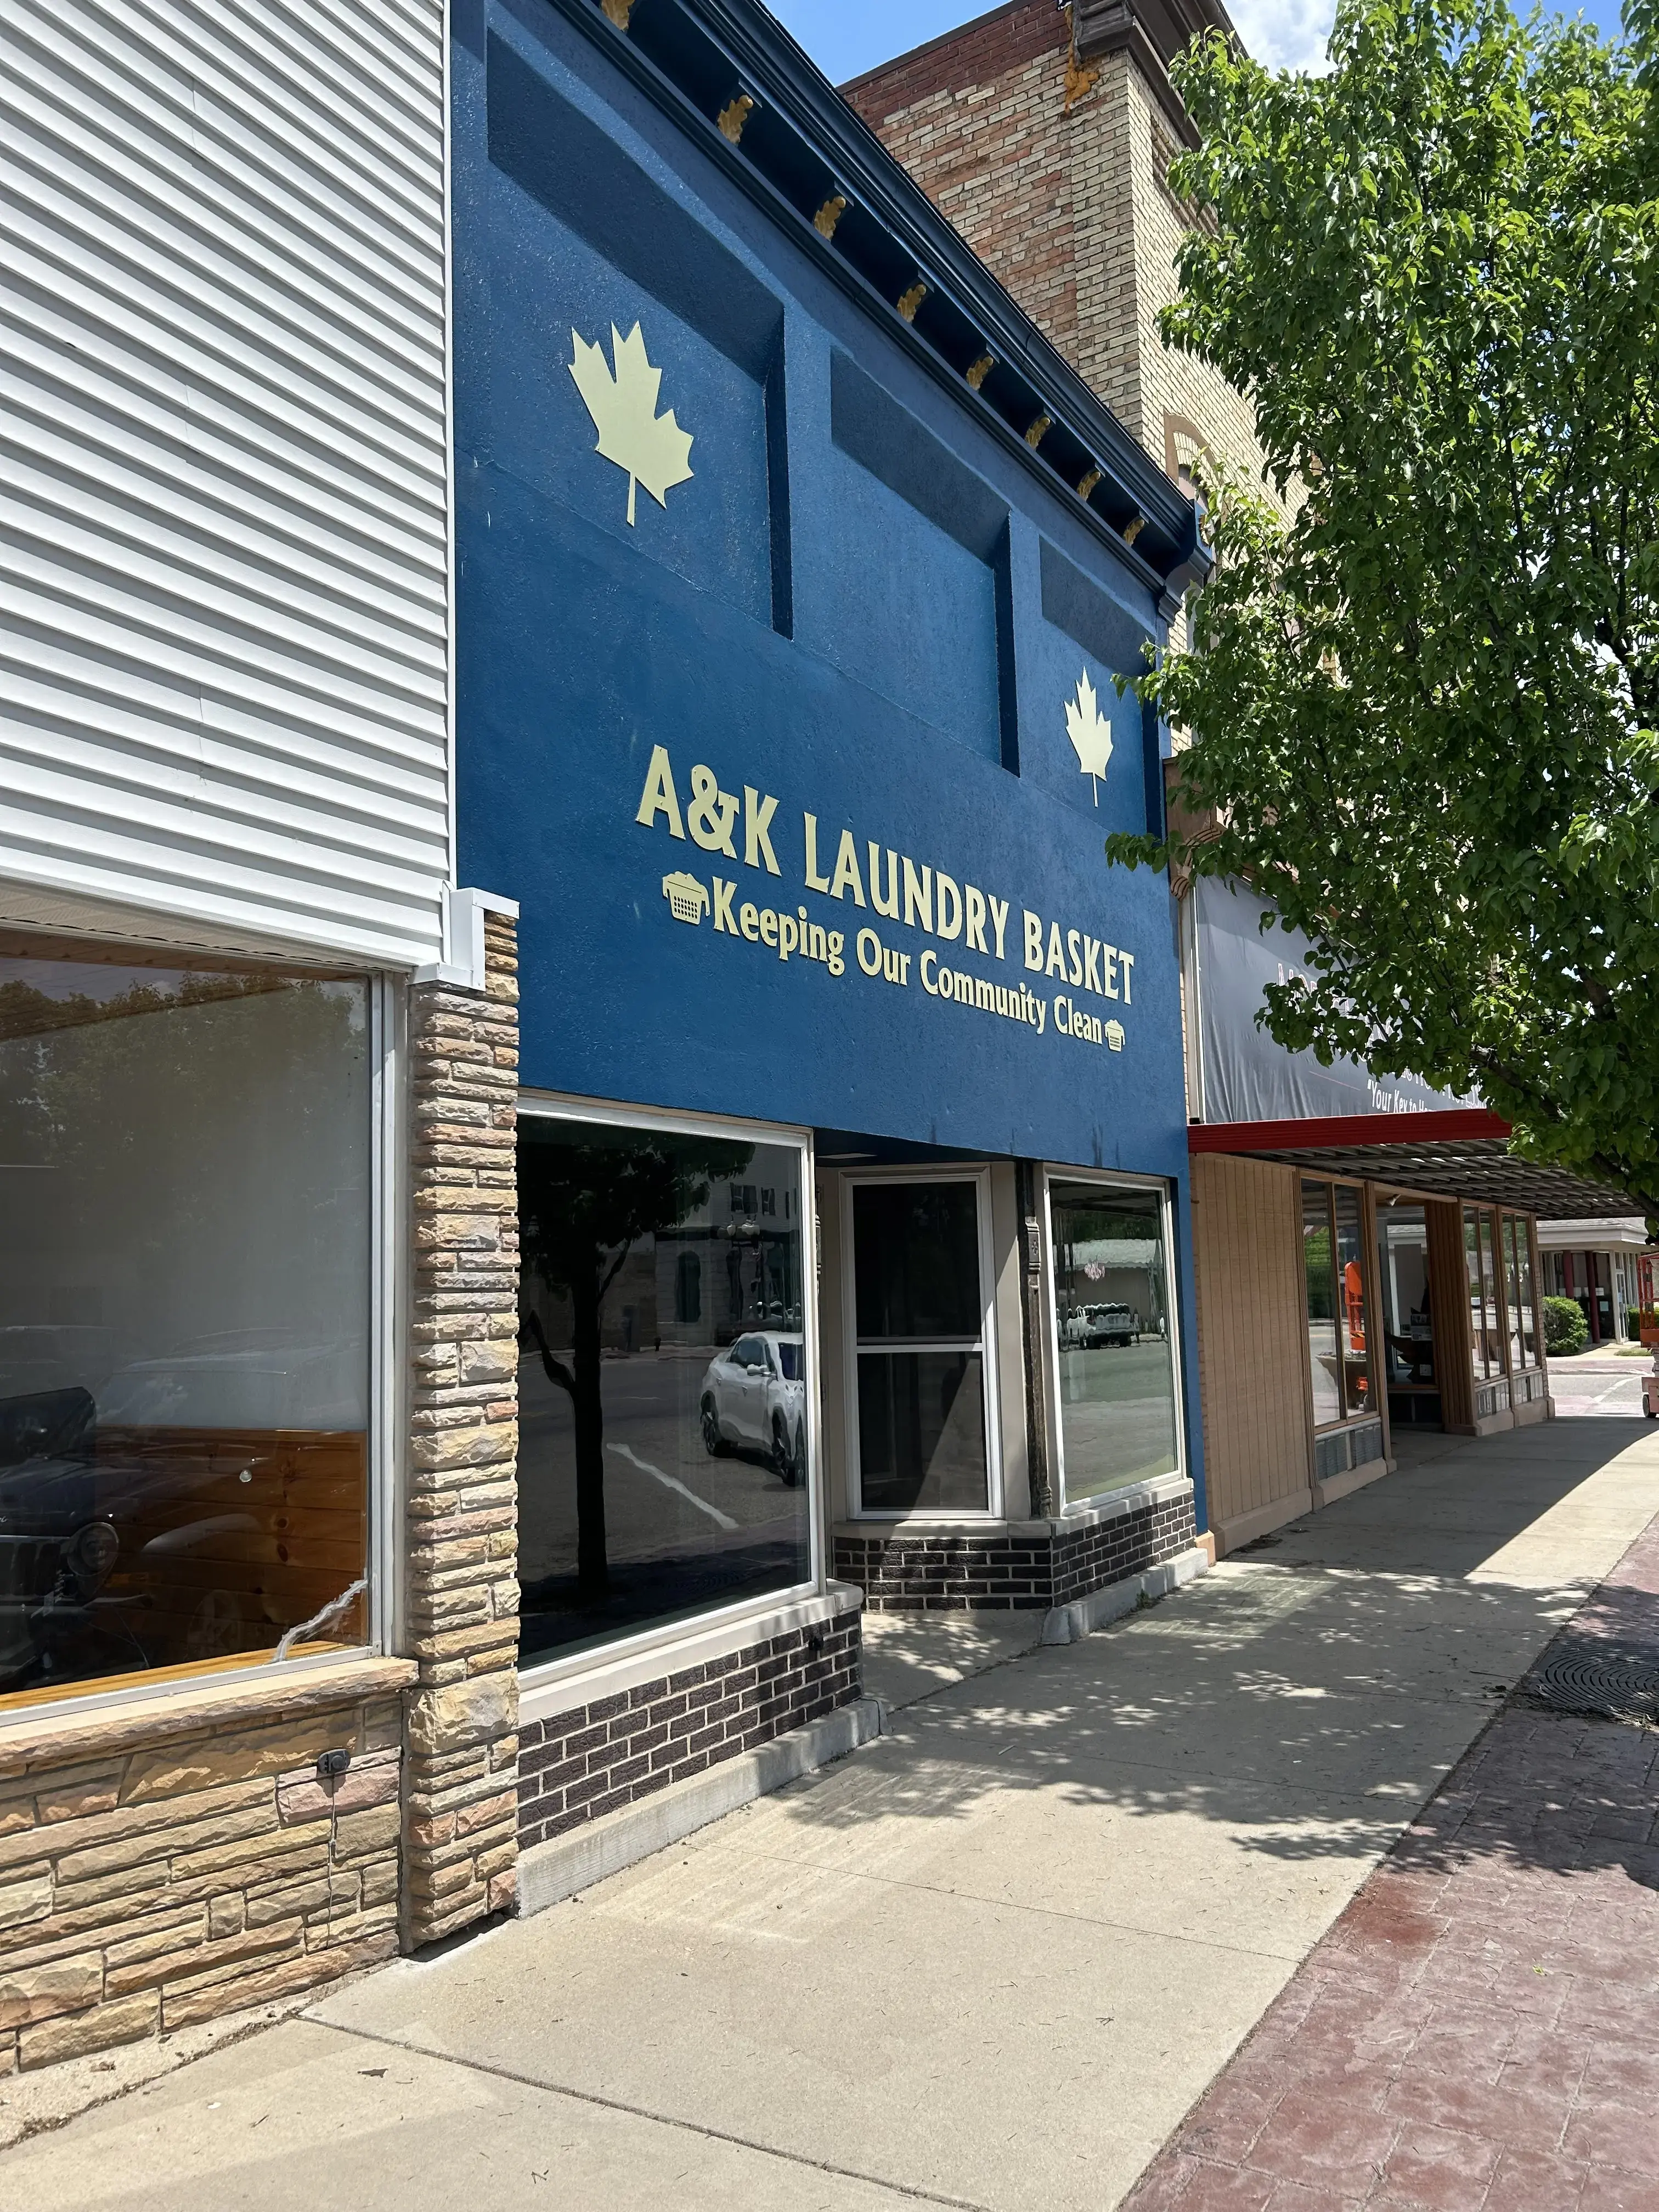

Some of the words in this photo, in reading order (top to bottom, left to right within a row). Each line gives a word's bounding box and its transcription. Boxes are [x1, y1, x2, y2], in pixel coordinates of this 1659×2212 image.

[635, 744, 782, 877] A&K
[804, 811, 1010, 960] LAUNDRY
[1023, 909, 1134, 1005] BASKET
[712, 876, 845, 977] Keeping
[856, 928, 911, 986] Our
[919, 950, 1047, 1035] Community
[1053, 995, 1103, 1045] Clean
